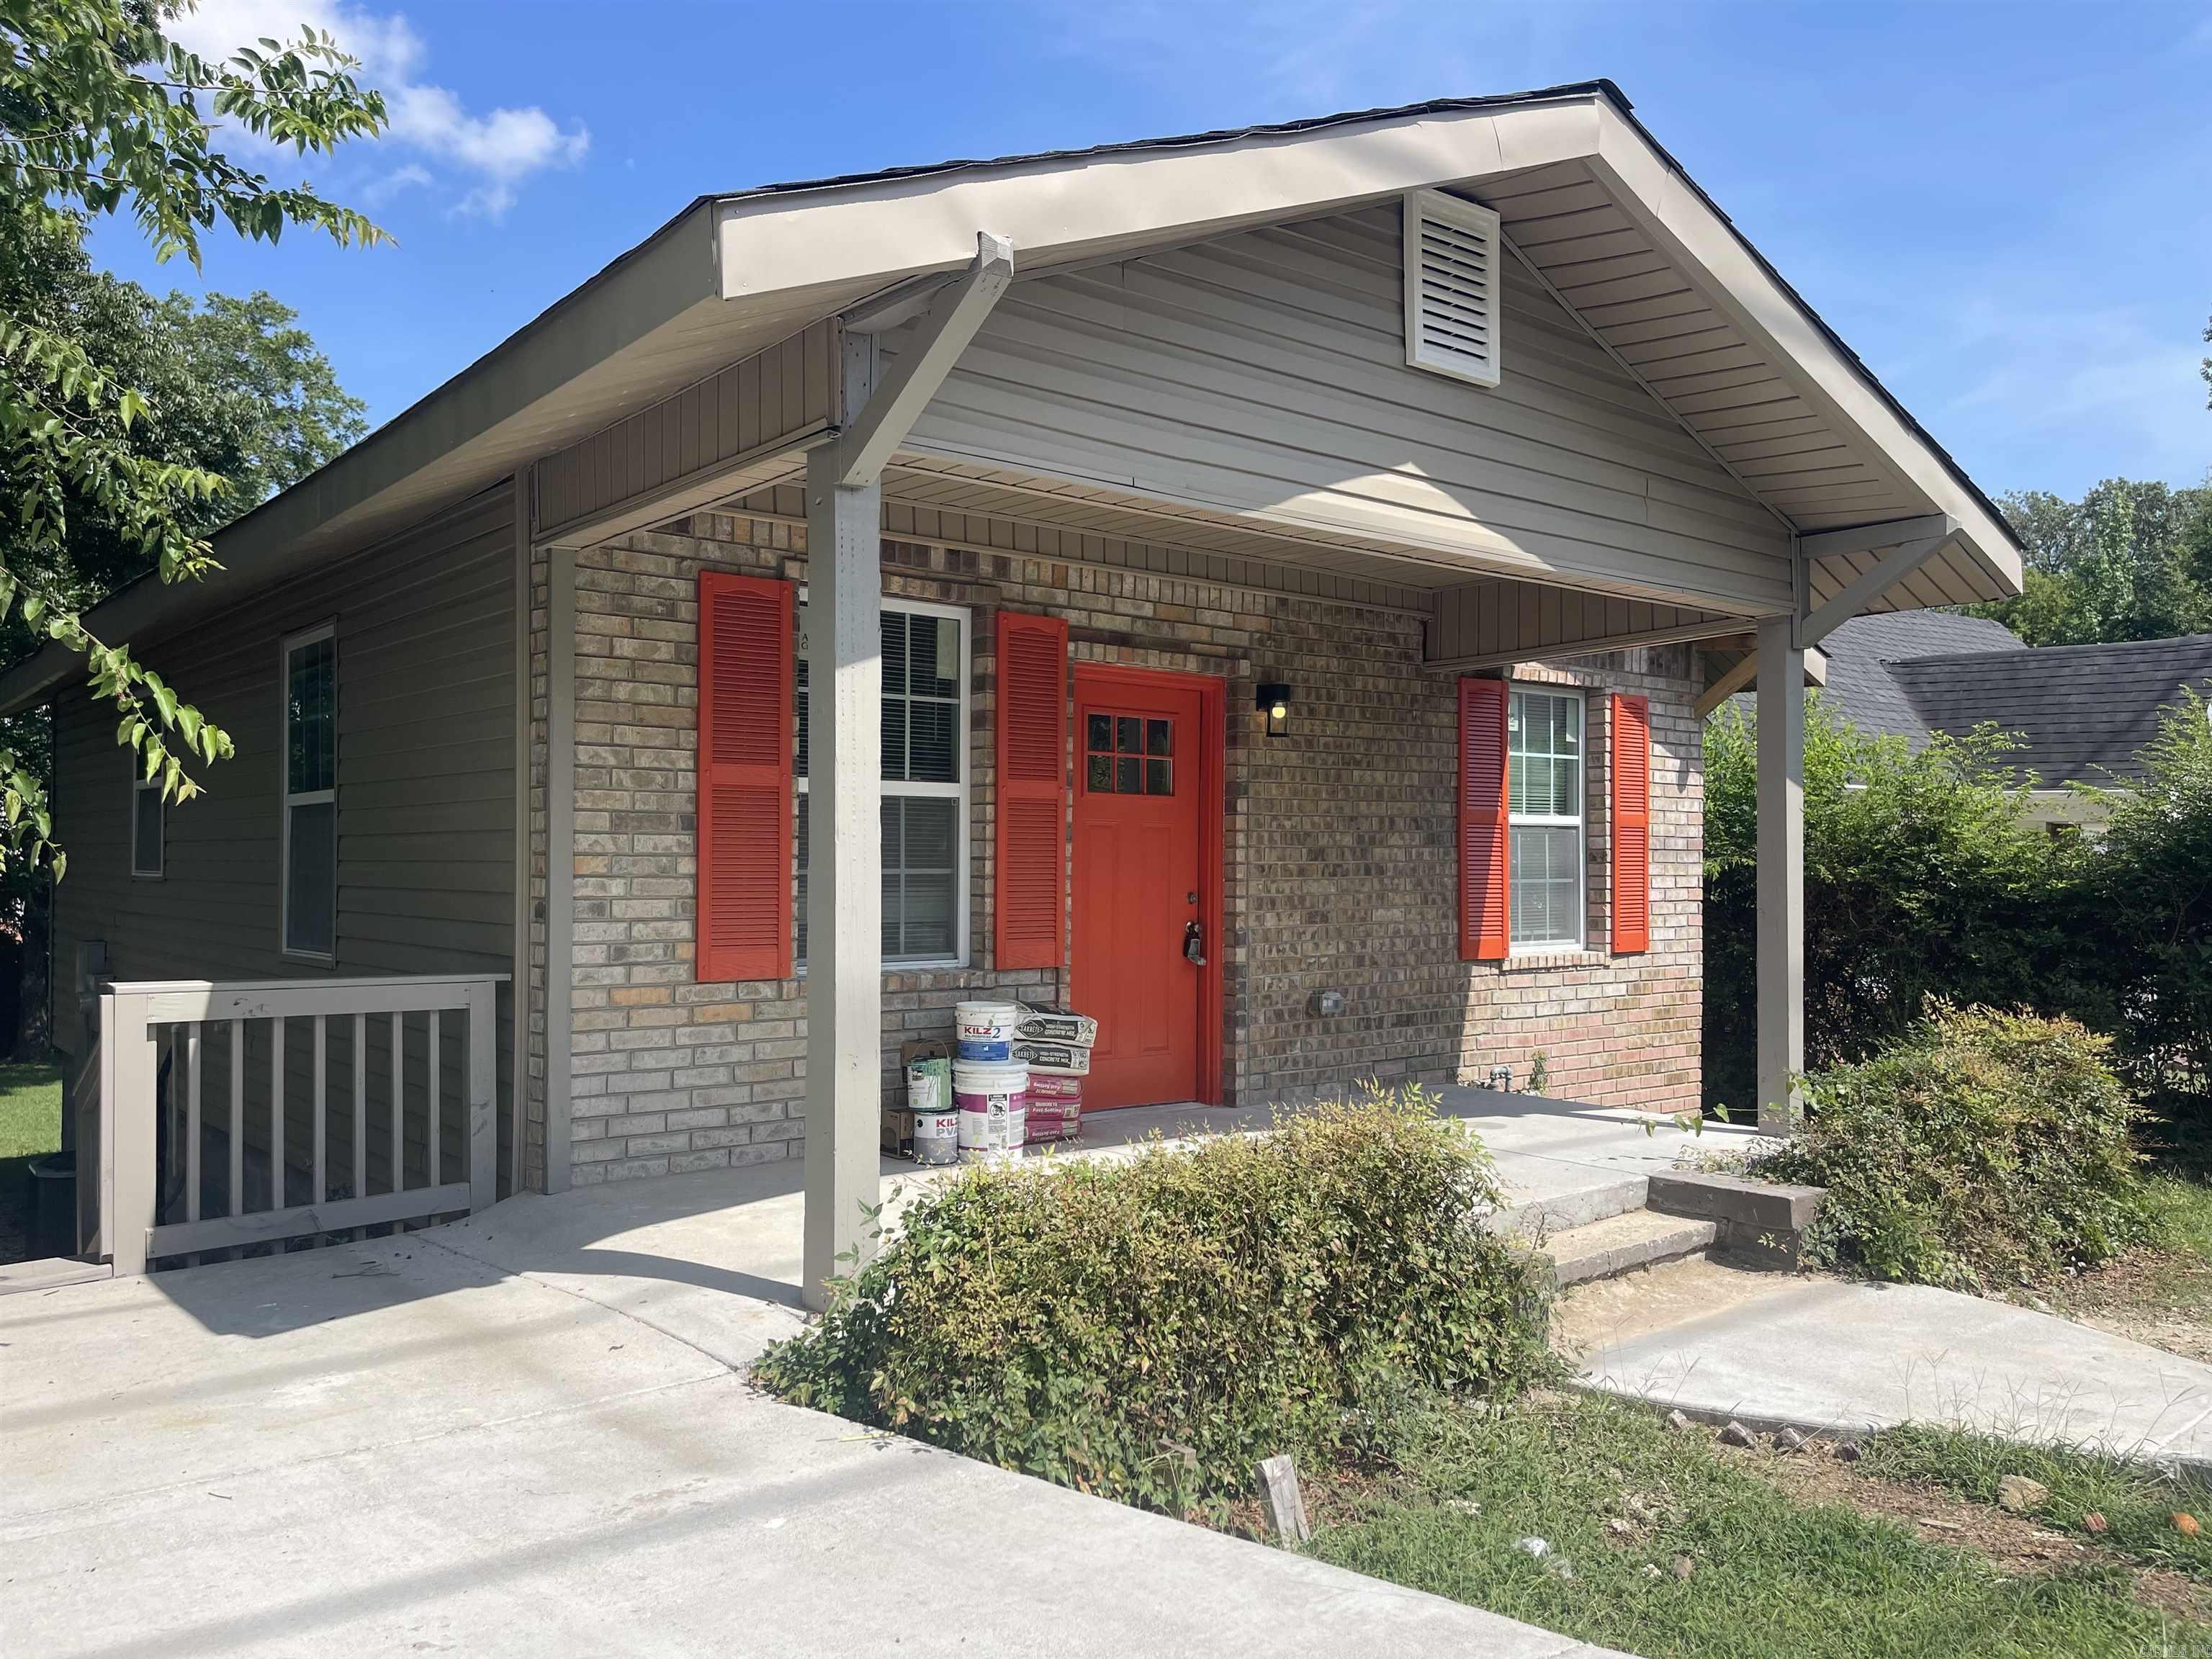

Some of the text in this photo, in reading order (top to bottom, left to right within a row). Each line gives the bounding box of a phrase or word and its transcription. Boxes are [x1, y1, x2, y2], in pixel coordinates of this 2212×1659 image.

[964, 1026, 1001, 1038] KILZ 2
[936, 1118, 957, 1128] KIL
